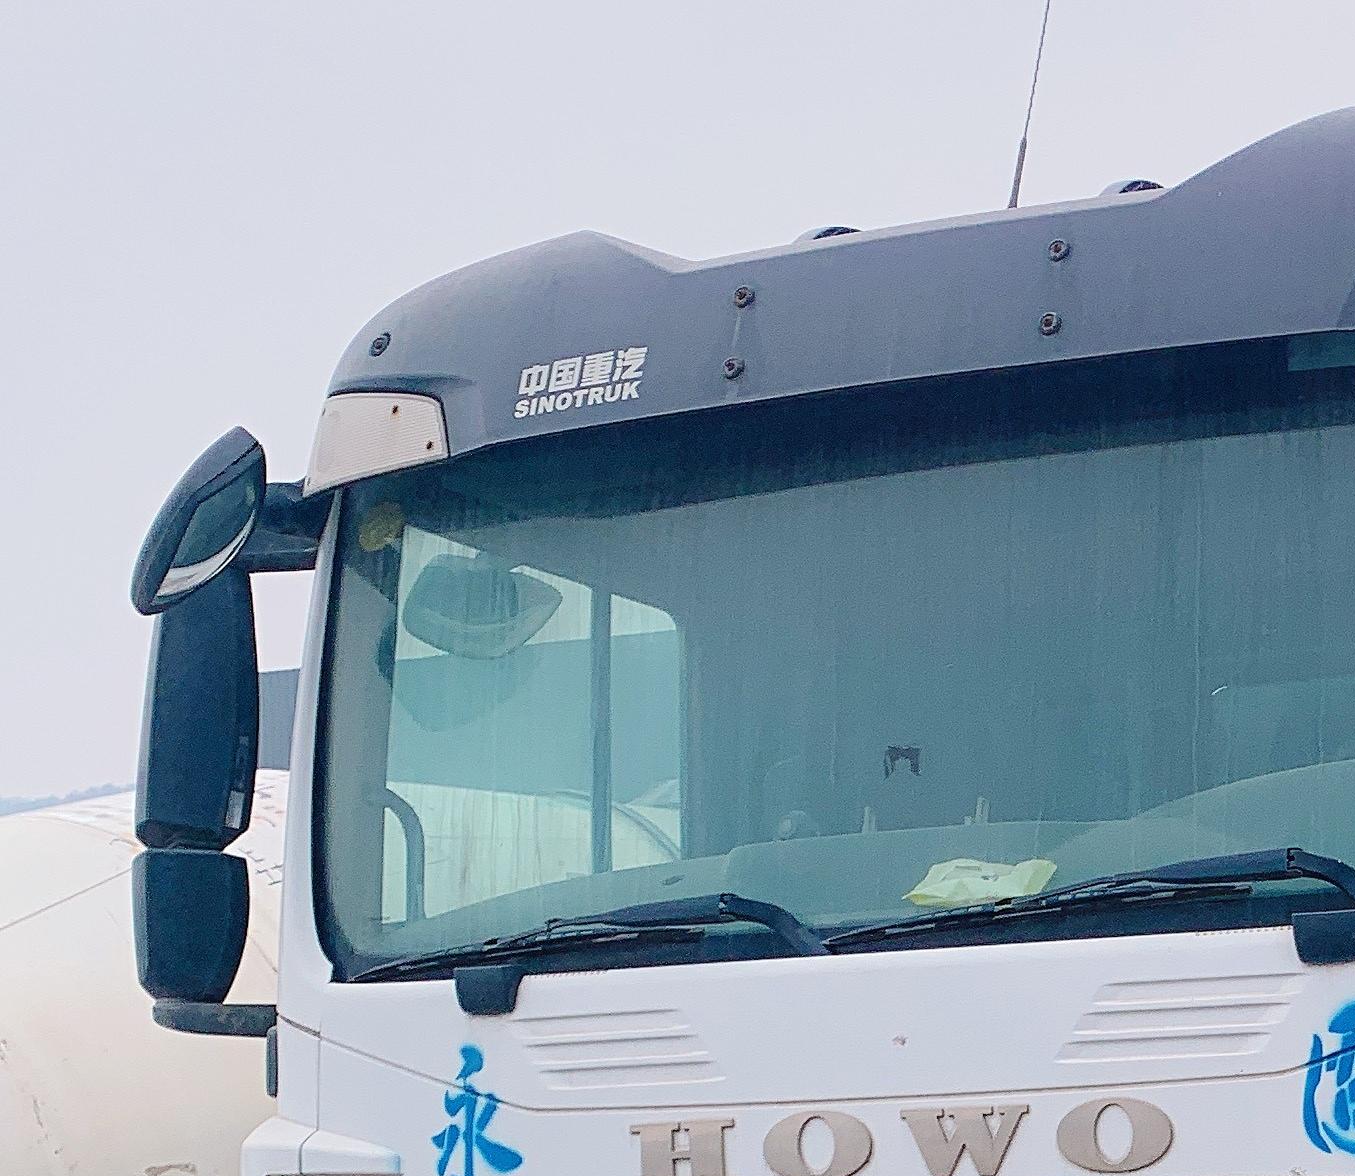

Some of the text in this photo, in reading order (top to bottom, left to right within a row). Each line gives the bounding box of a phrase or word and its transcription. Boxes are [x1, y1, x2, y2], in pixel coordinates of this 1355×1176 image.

[519, 347, 648, 396] 中国重汽
[514, 381, 642, 418] SINOTRUK
